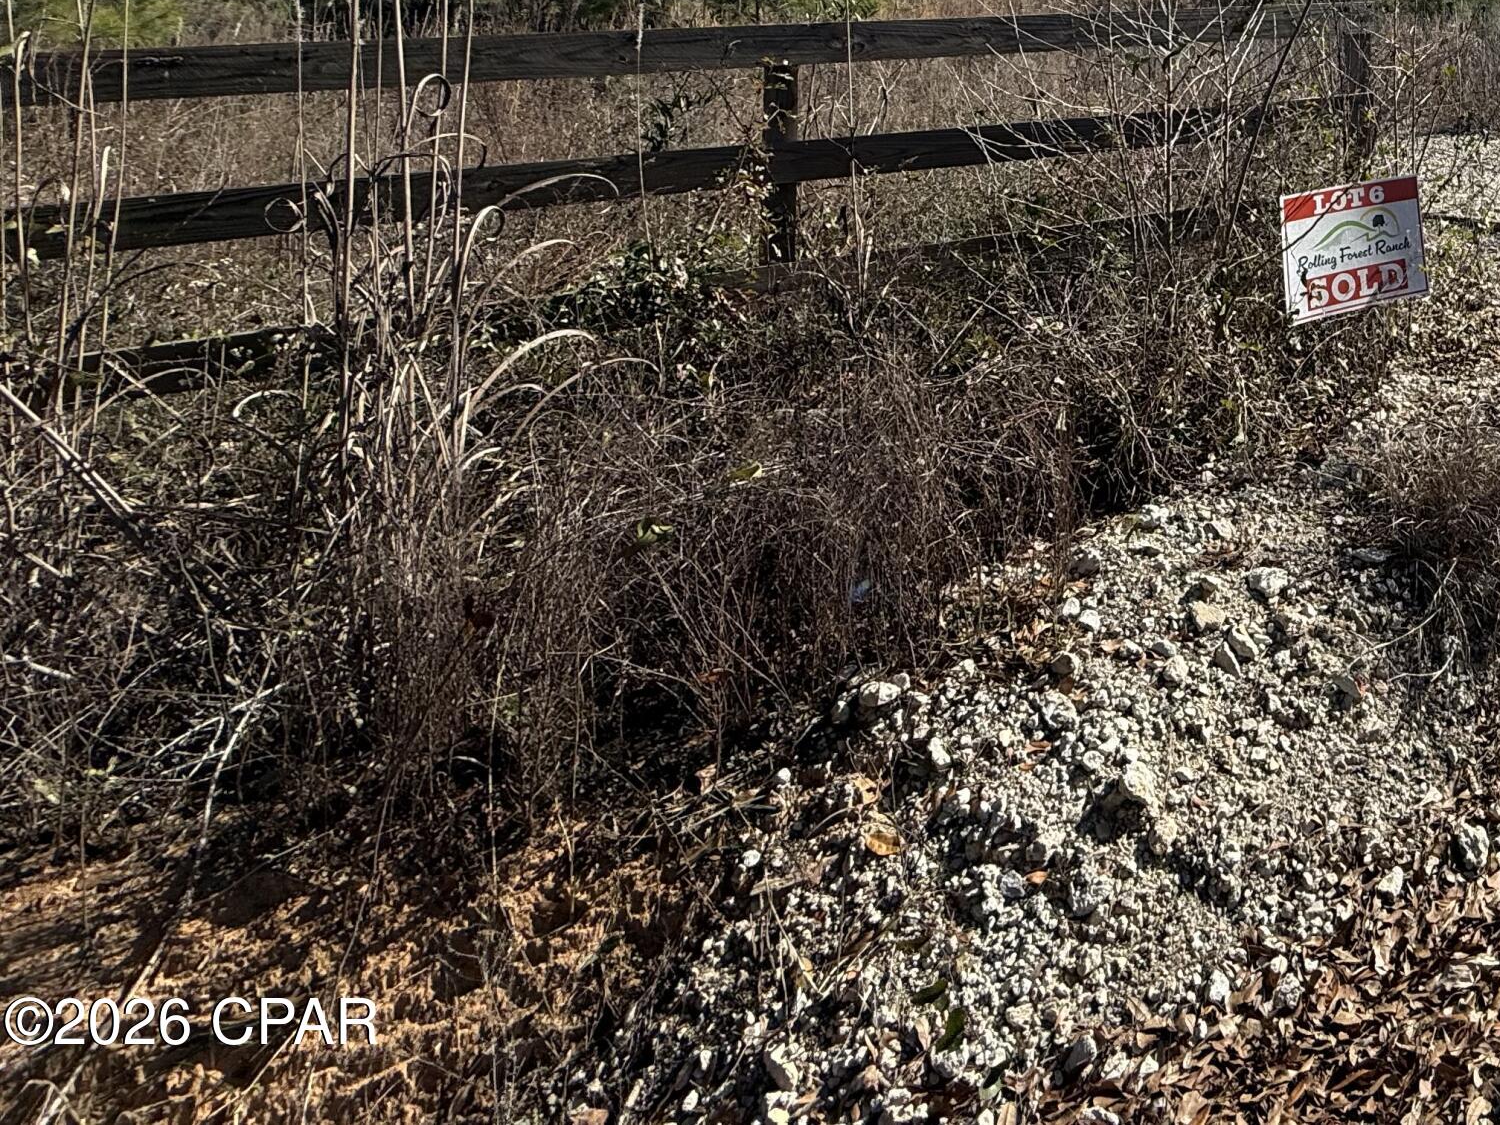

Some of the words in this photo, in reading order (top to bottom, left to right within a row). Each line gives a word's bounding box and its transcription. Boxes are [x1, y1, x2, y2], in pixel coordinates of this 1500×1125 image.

[1313, 190, 1364, 214] LOT
[1369, 185, 1385, 204] 6
[1296, 256, 1337, 275] Rolling
[1339, 245, 1373, 263] Forest
[1375, 236, 1412, 256] Ranch
[1309, 263, 1406, 308] SOLD
